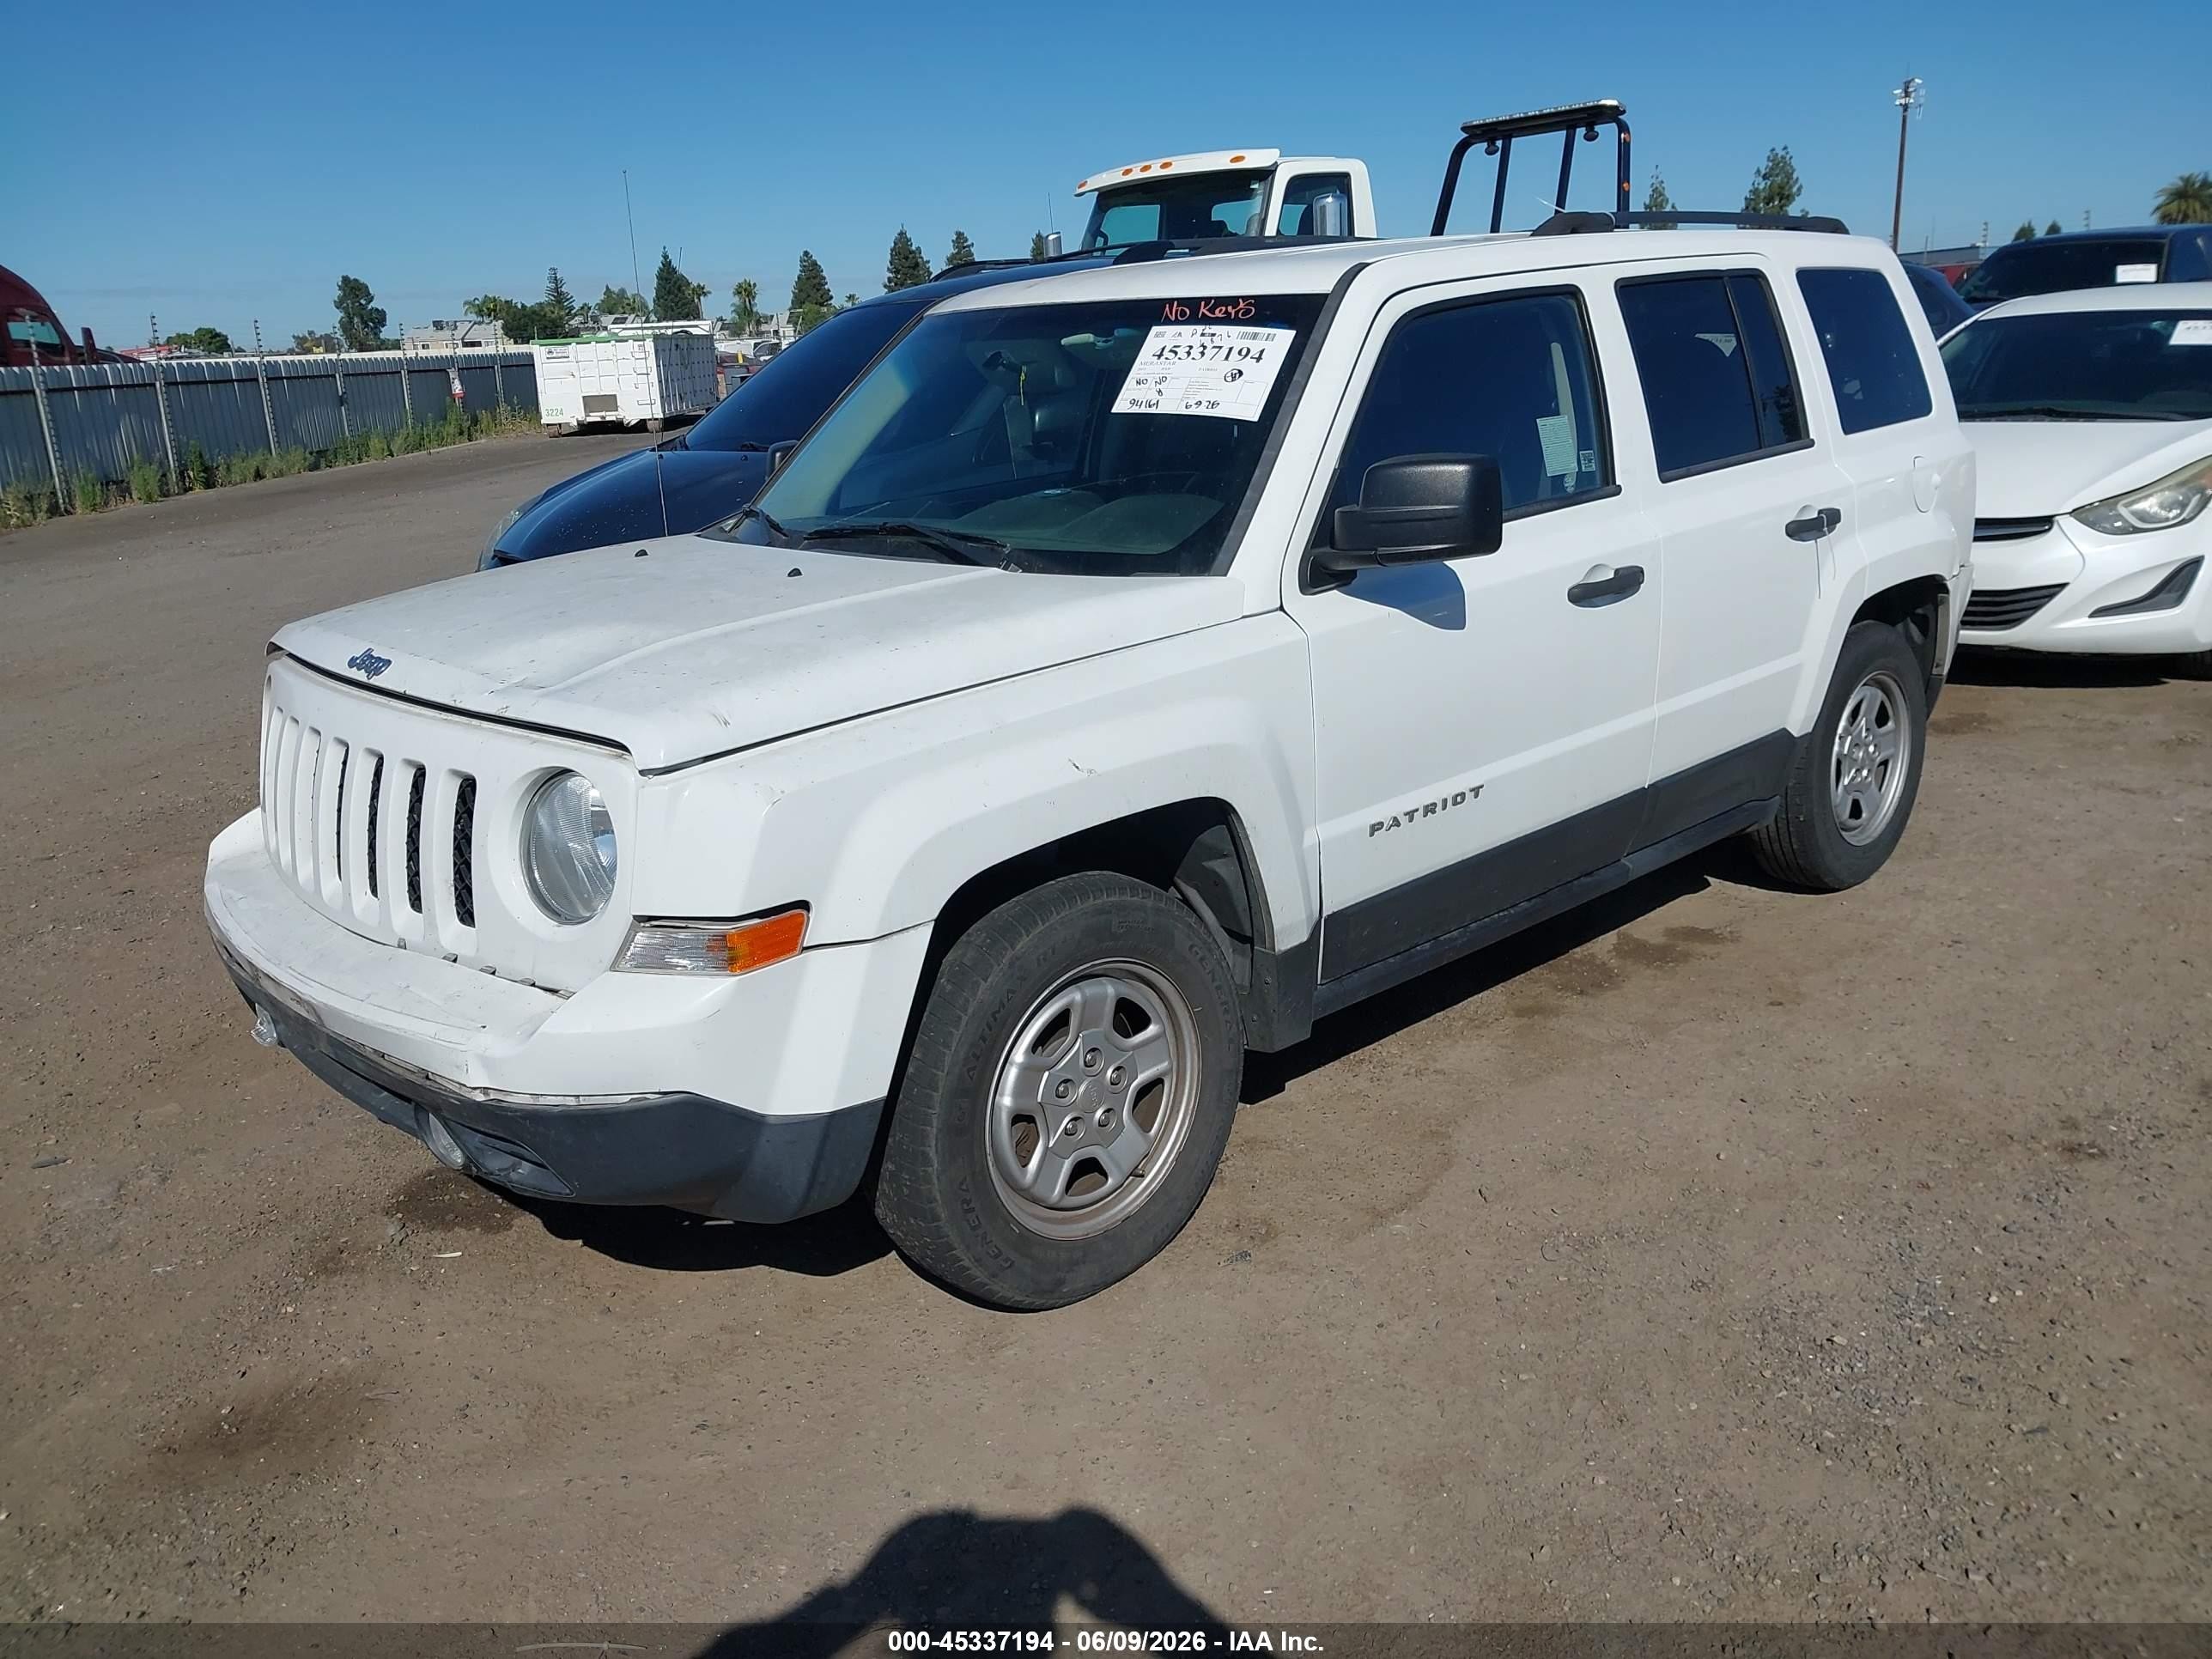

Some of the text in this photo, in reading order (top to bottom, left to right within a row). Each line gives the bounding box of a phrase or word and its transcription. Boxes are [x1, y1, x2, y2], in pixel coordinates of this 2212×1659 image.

[1152, 344, 1267, 364] 45337194
[545, 408, 563, 417] 3224
[347, 647, 392, 680] Jeep
[1369, 783, 1485, 837] PATRIOT
